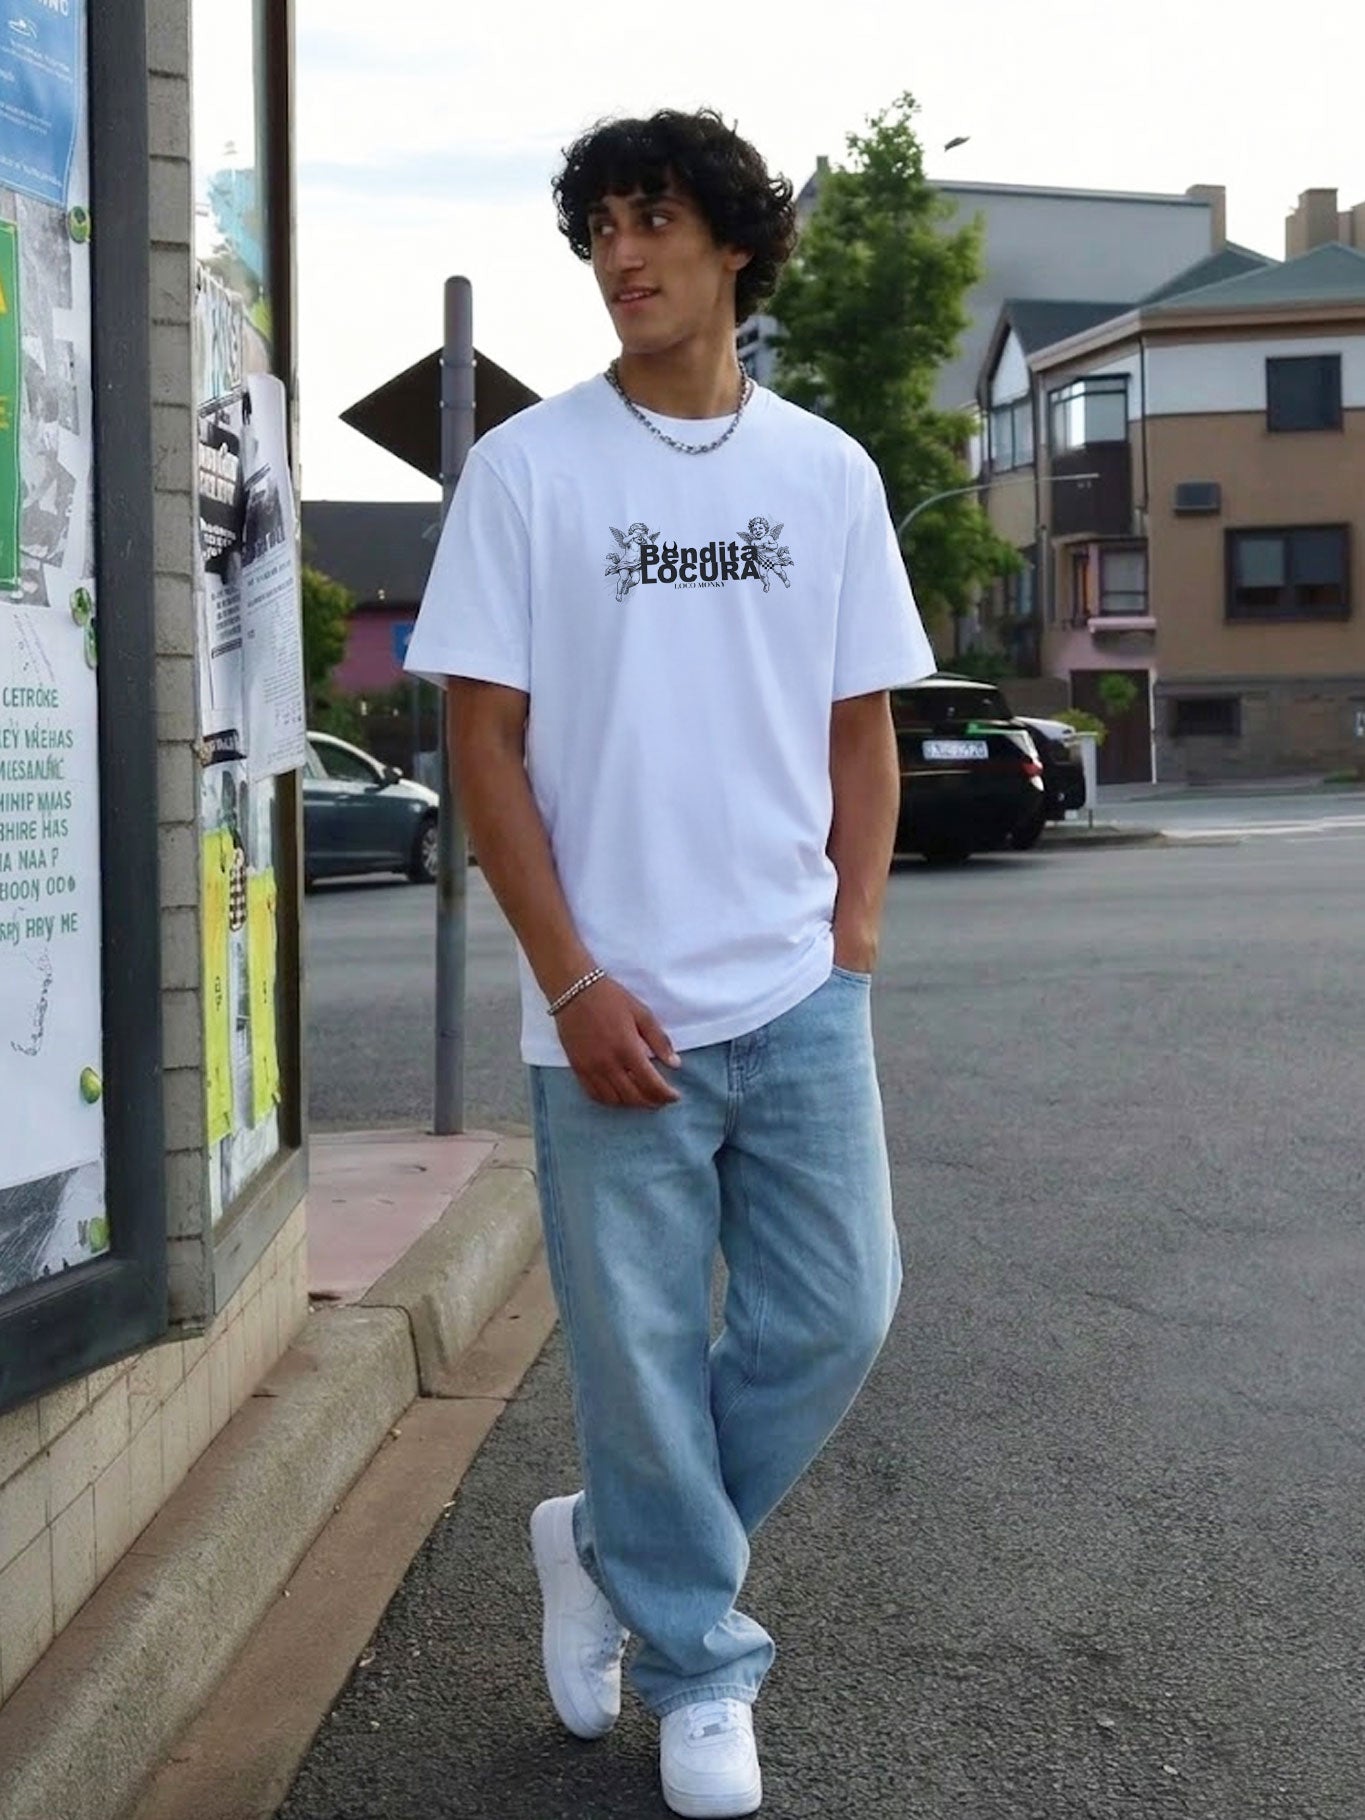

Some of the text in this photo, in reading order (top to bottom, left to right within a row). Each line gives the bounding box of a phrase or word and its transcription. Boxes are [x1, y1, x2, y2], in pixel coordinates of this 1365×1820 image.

[640, 540, 757, 566] Bendita
[641, 560, 760, 584] LOCURA
[674, 582, 696, 590] LOCO
